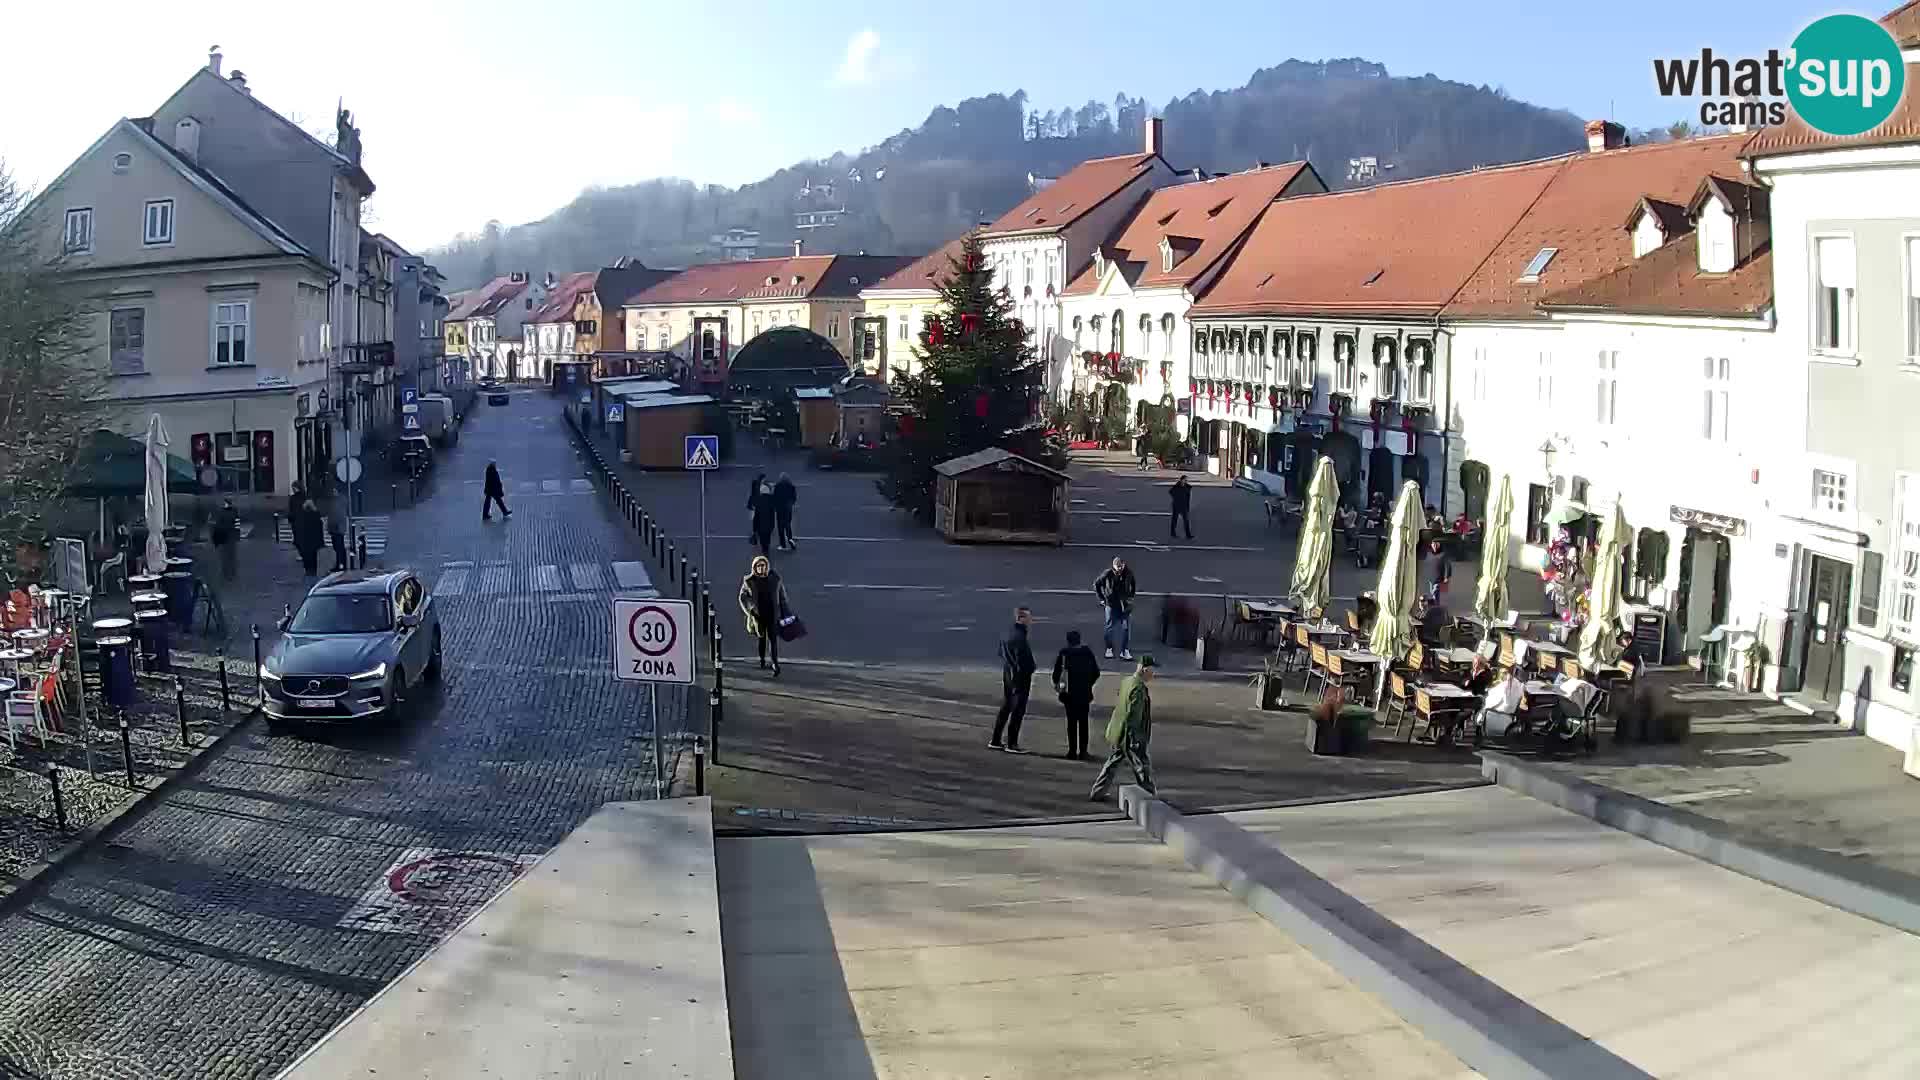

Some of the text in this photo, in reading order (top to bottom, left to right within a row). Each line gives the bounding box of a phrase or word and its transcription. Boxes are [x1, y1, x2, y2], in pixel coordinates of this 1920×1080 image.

[406, 391, 414, 403] P
[641, 621, 666, 643] 30
[632, 659, 676, 677] ZONA
